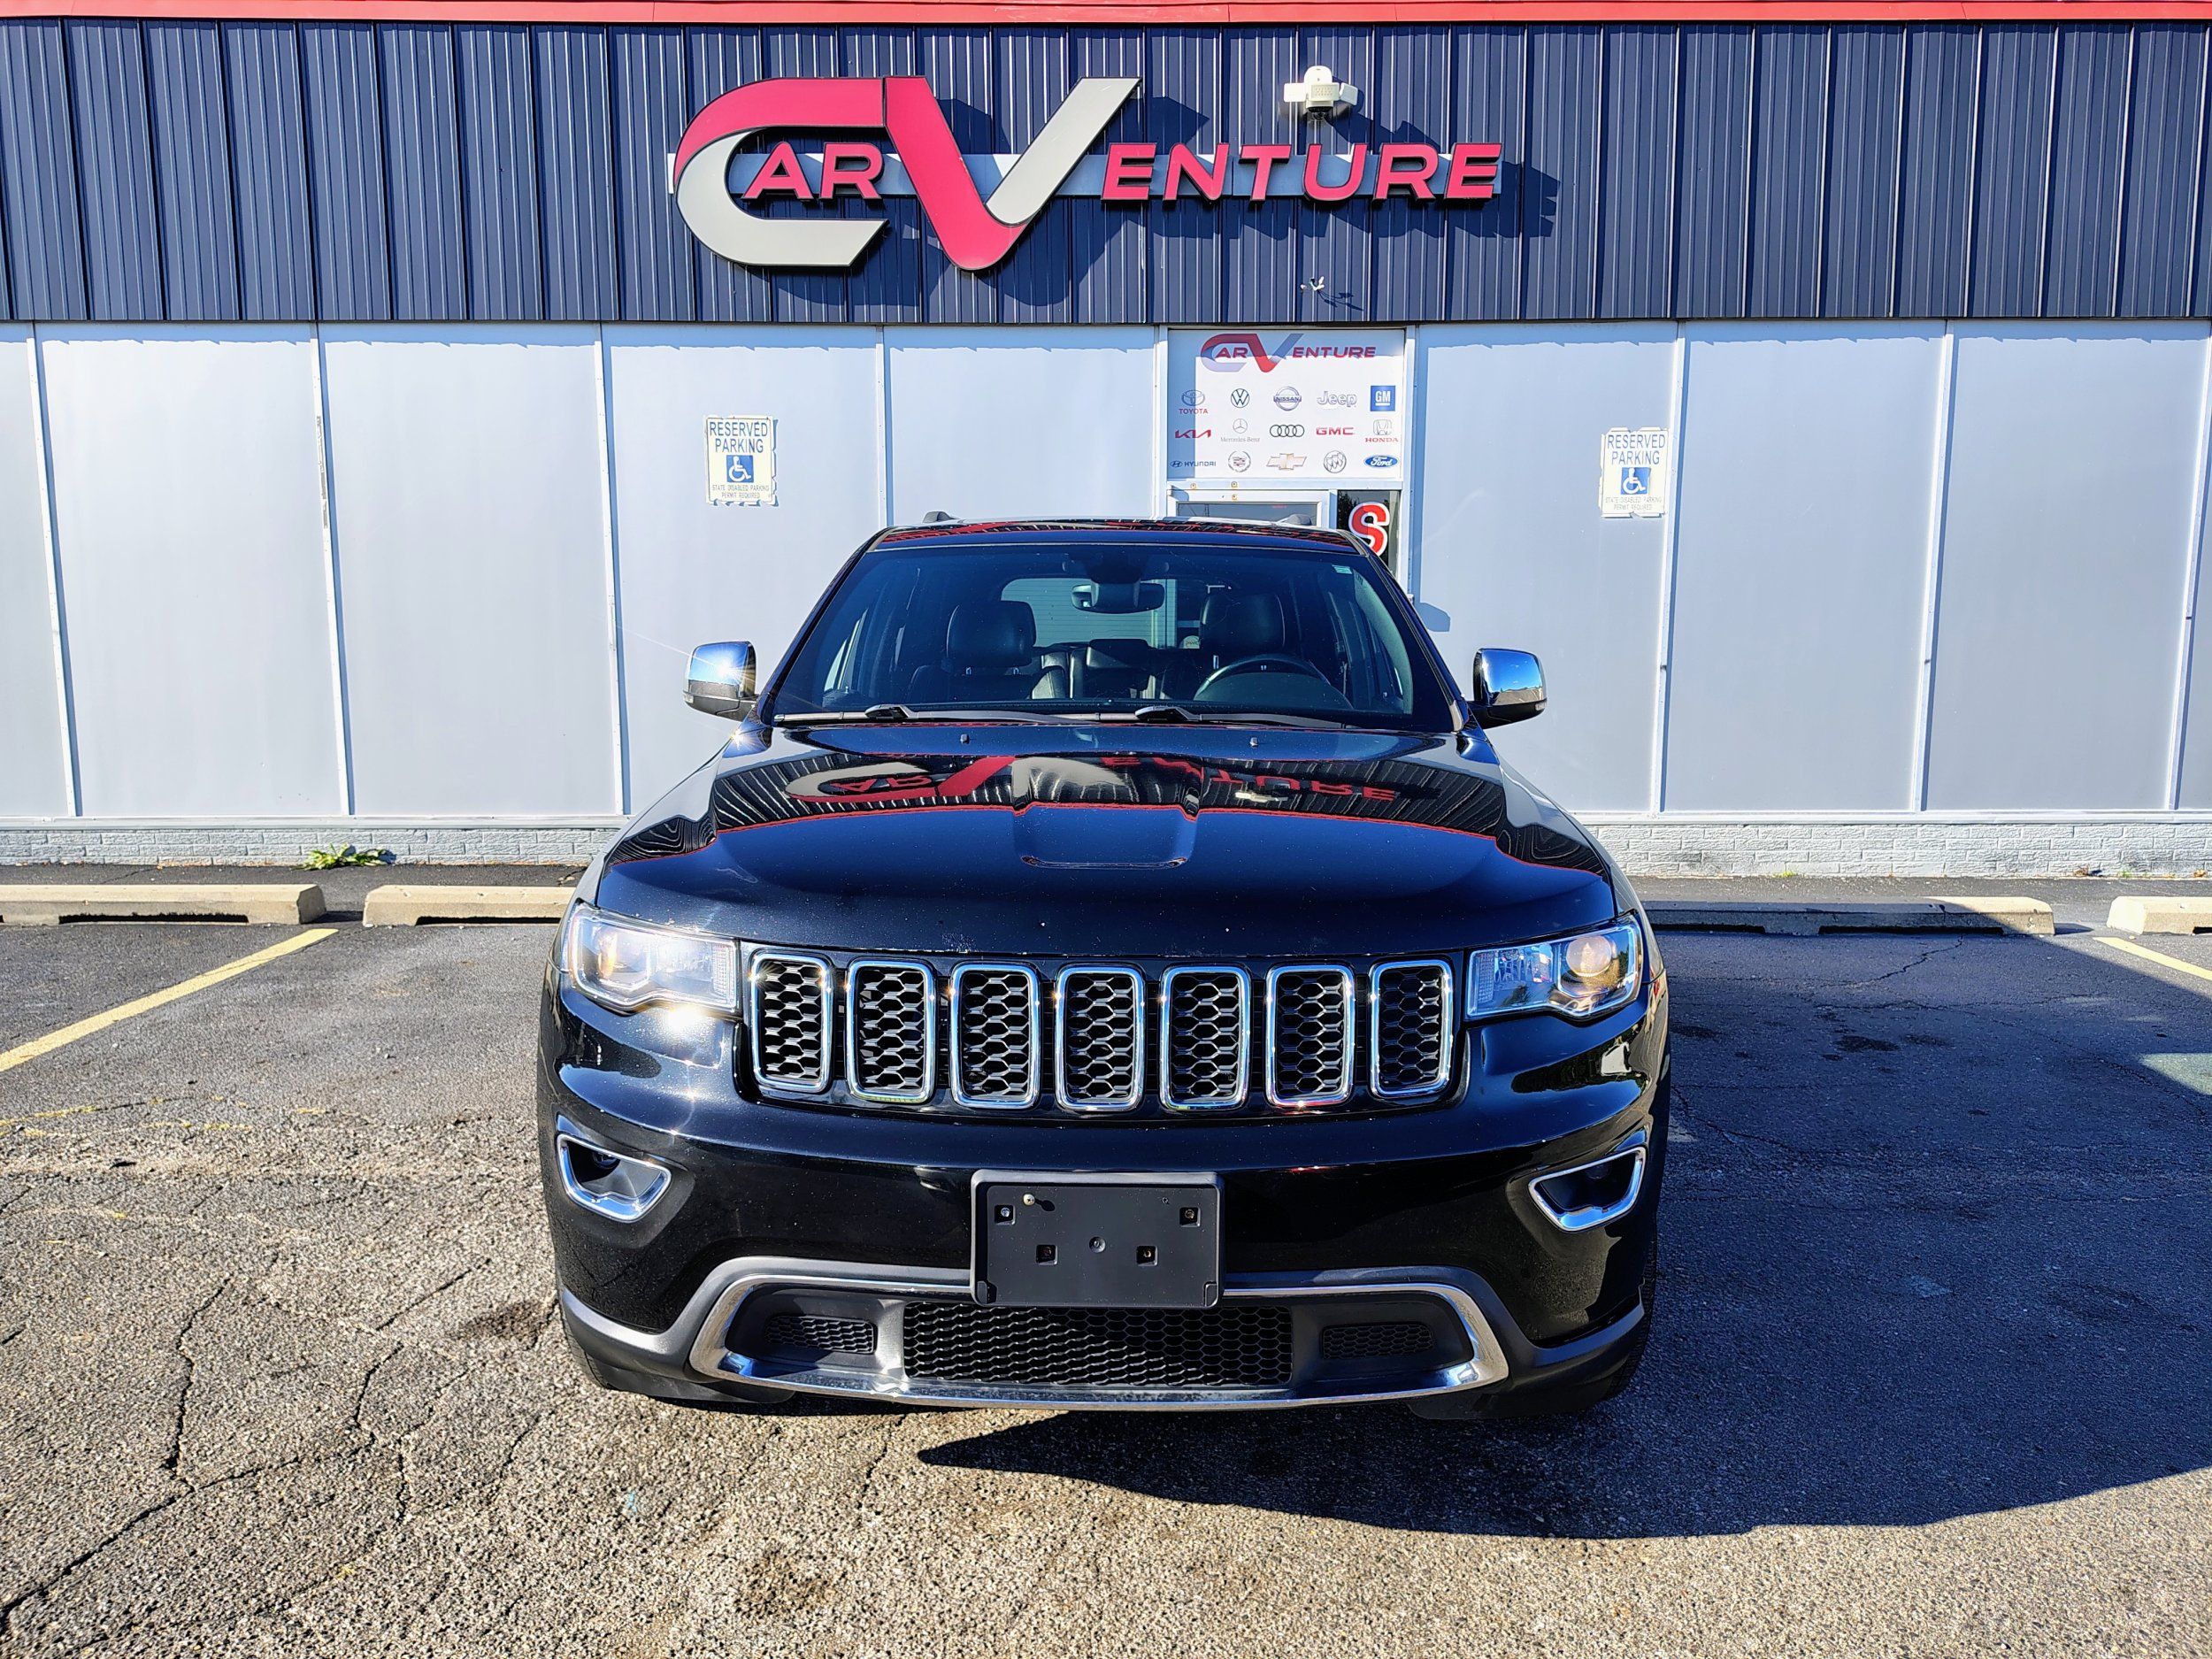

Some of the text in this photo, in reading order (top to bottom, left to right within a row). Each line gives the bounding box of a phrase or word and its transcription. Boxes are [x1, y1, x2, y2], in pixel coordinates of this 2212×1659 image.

[1317, 390, 1357, 408] Jeep
[1375, 390, 1391, 403] GM
[710, 421, 768, 436] RESERVED
[1174, 429, 1211, 439] KIA
[1316, 426, 1354, 435] GMC
[715, 438, 764, 453] PARKING
[1607, 434, 1665, 449] RESERVED
[1370, 456, 1394, 466] Ford
[1611, 450, 1660, 465] PARKING
